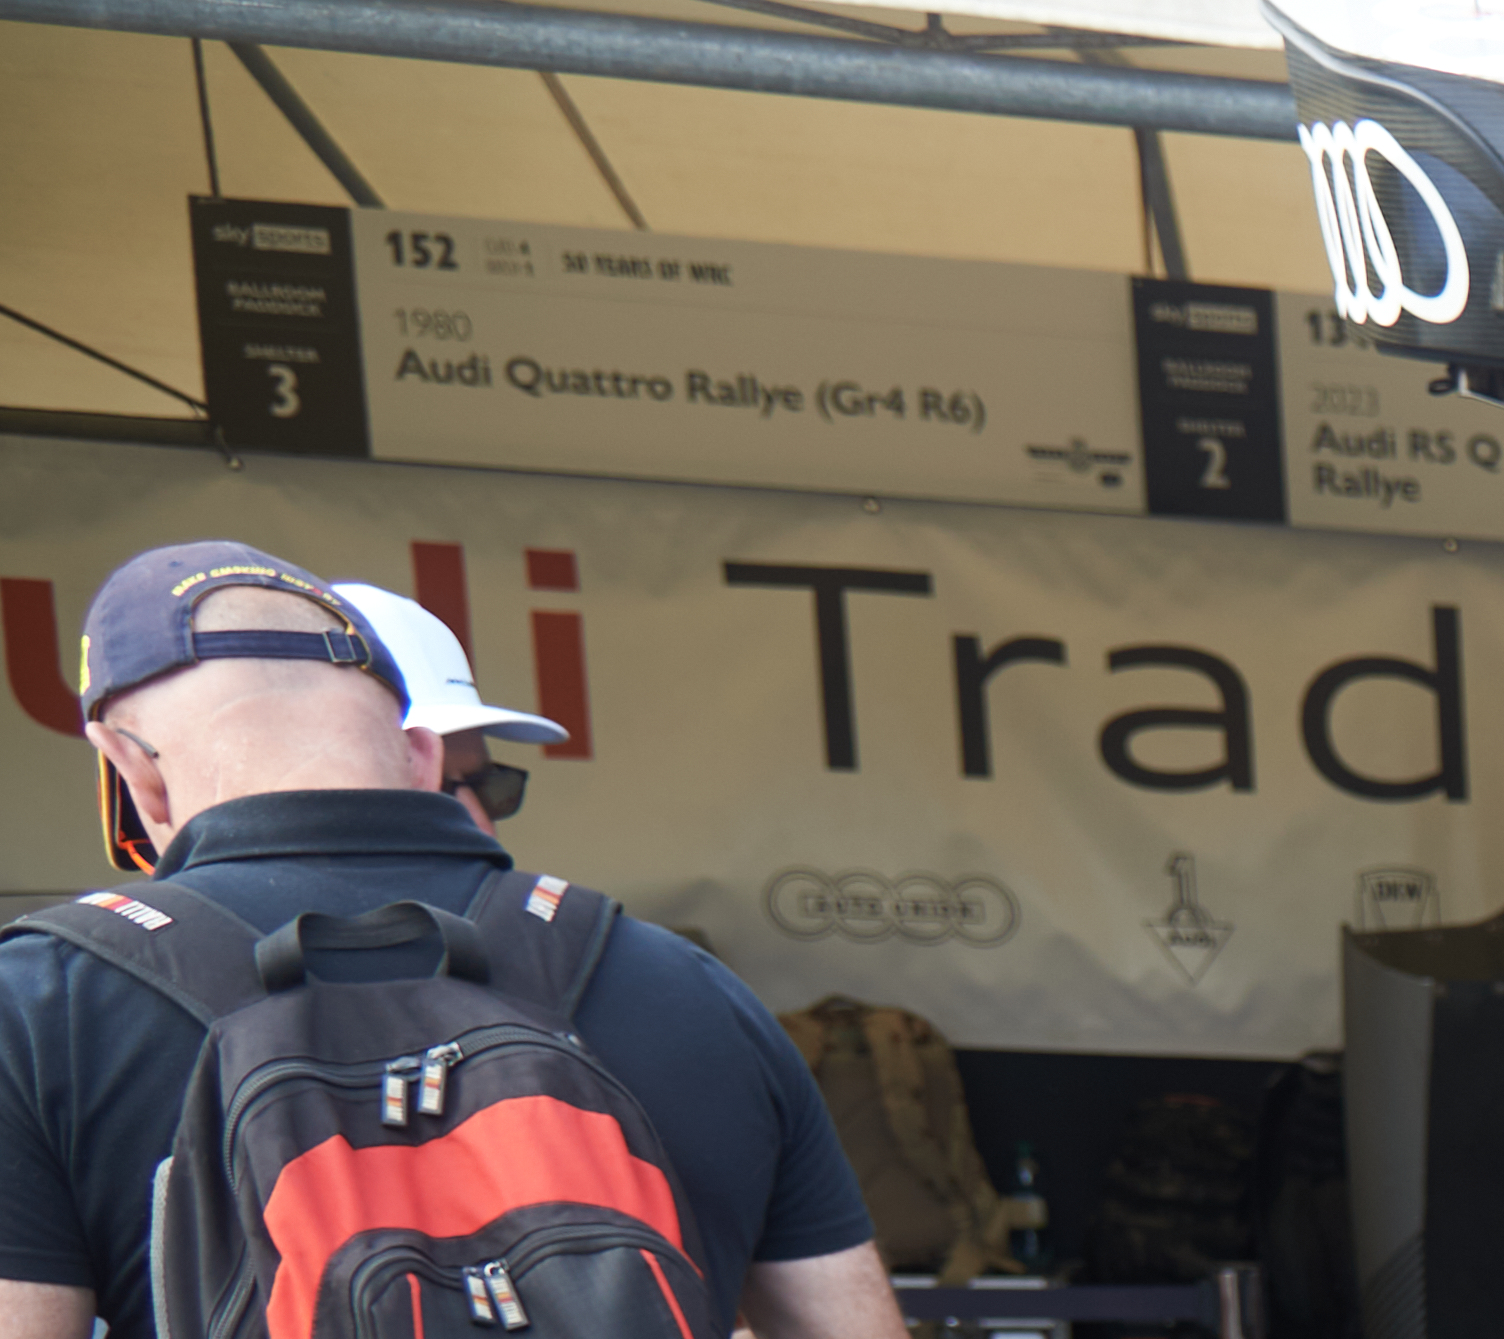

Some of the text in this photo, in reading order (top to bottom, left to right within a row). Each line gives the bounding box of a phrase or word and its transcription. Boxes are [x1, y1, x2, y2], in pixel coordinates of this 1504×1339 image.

[385, 229, 459, 272] 152
[393, 308, 473, 342] 1980
[267, 363, 302, 419] 3
[395, 347, 988, 436] Audi Quattro Rallye (Gr4 R6)
[1197, 438, 1231, 490] 2
[1312, 423, 1397, 461] Audi
[1408, 429, 1456, 465] RS
[1467, 434, 1501, 473] Q
[1313, 462, 1421, 508] Rallye
